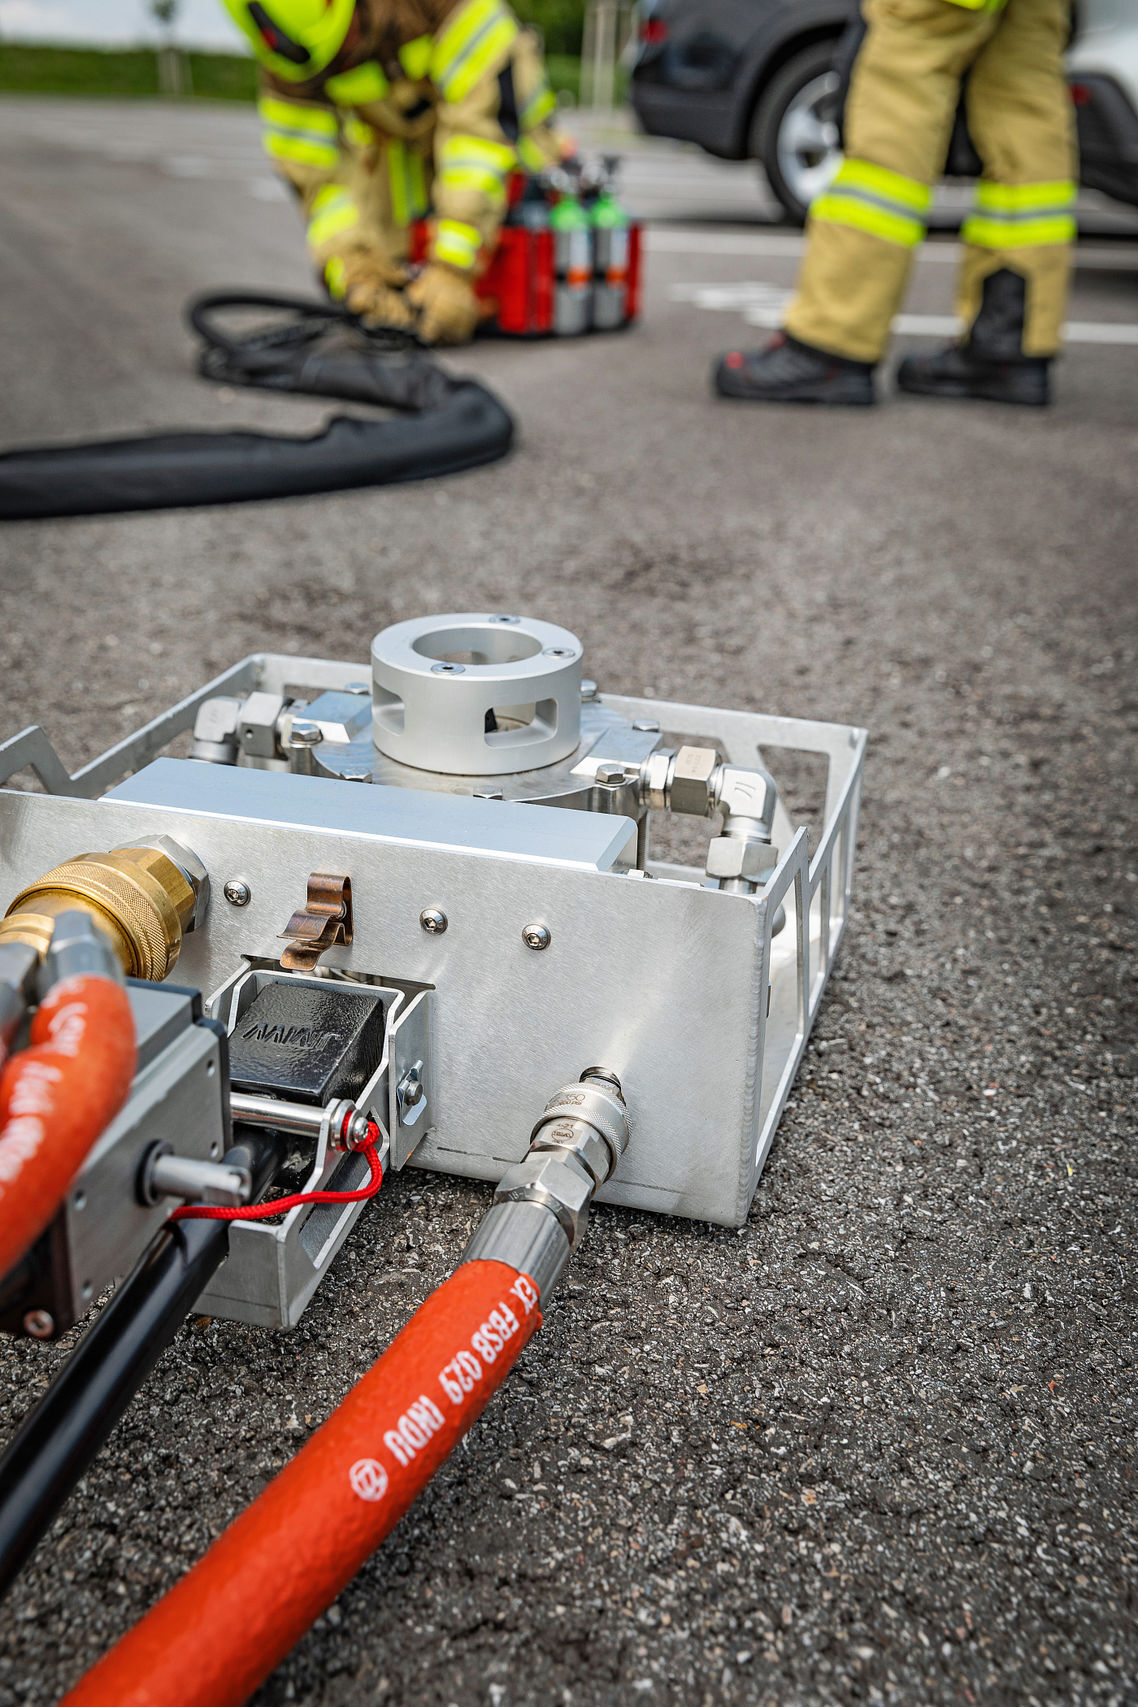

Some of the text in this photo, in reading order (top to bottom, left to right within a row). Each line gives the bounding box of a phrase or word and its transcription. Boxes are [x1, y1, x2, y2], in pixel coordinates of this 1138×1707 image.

[470, 1302, 520, 1364] FBSB
[438, 1350, 483, 1404] 029
[383, 1394, 445, 1467] INDU
